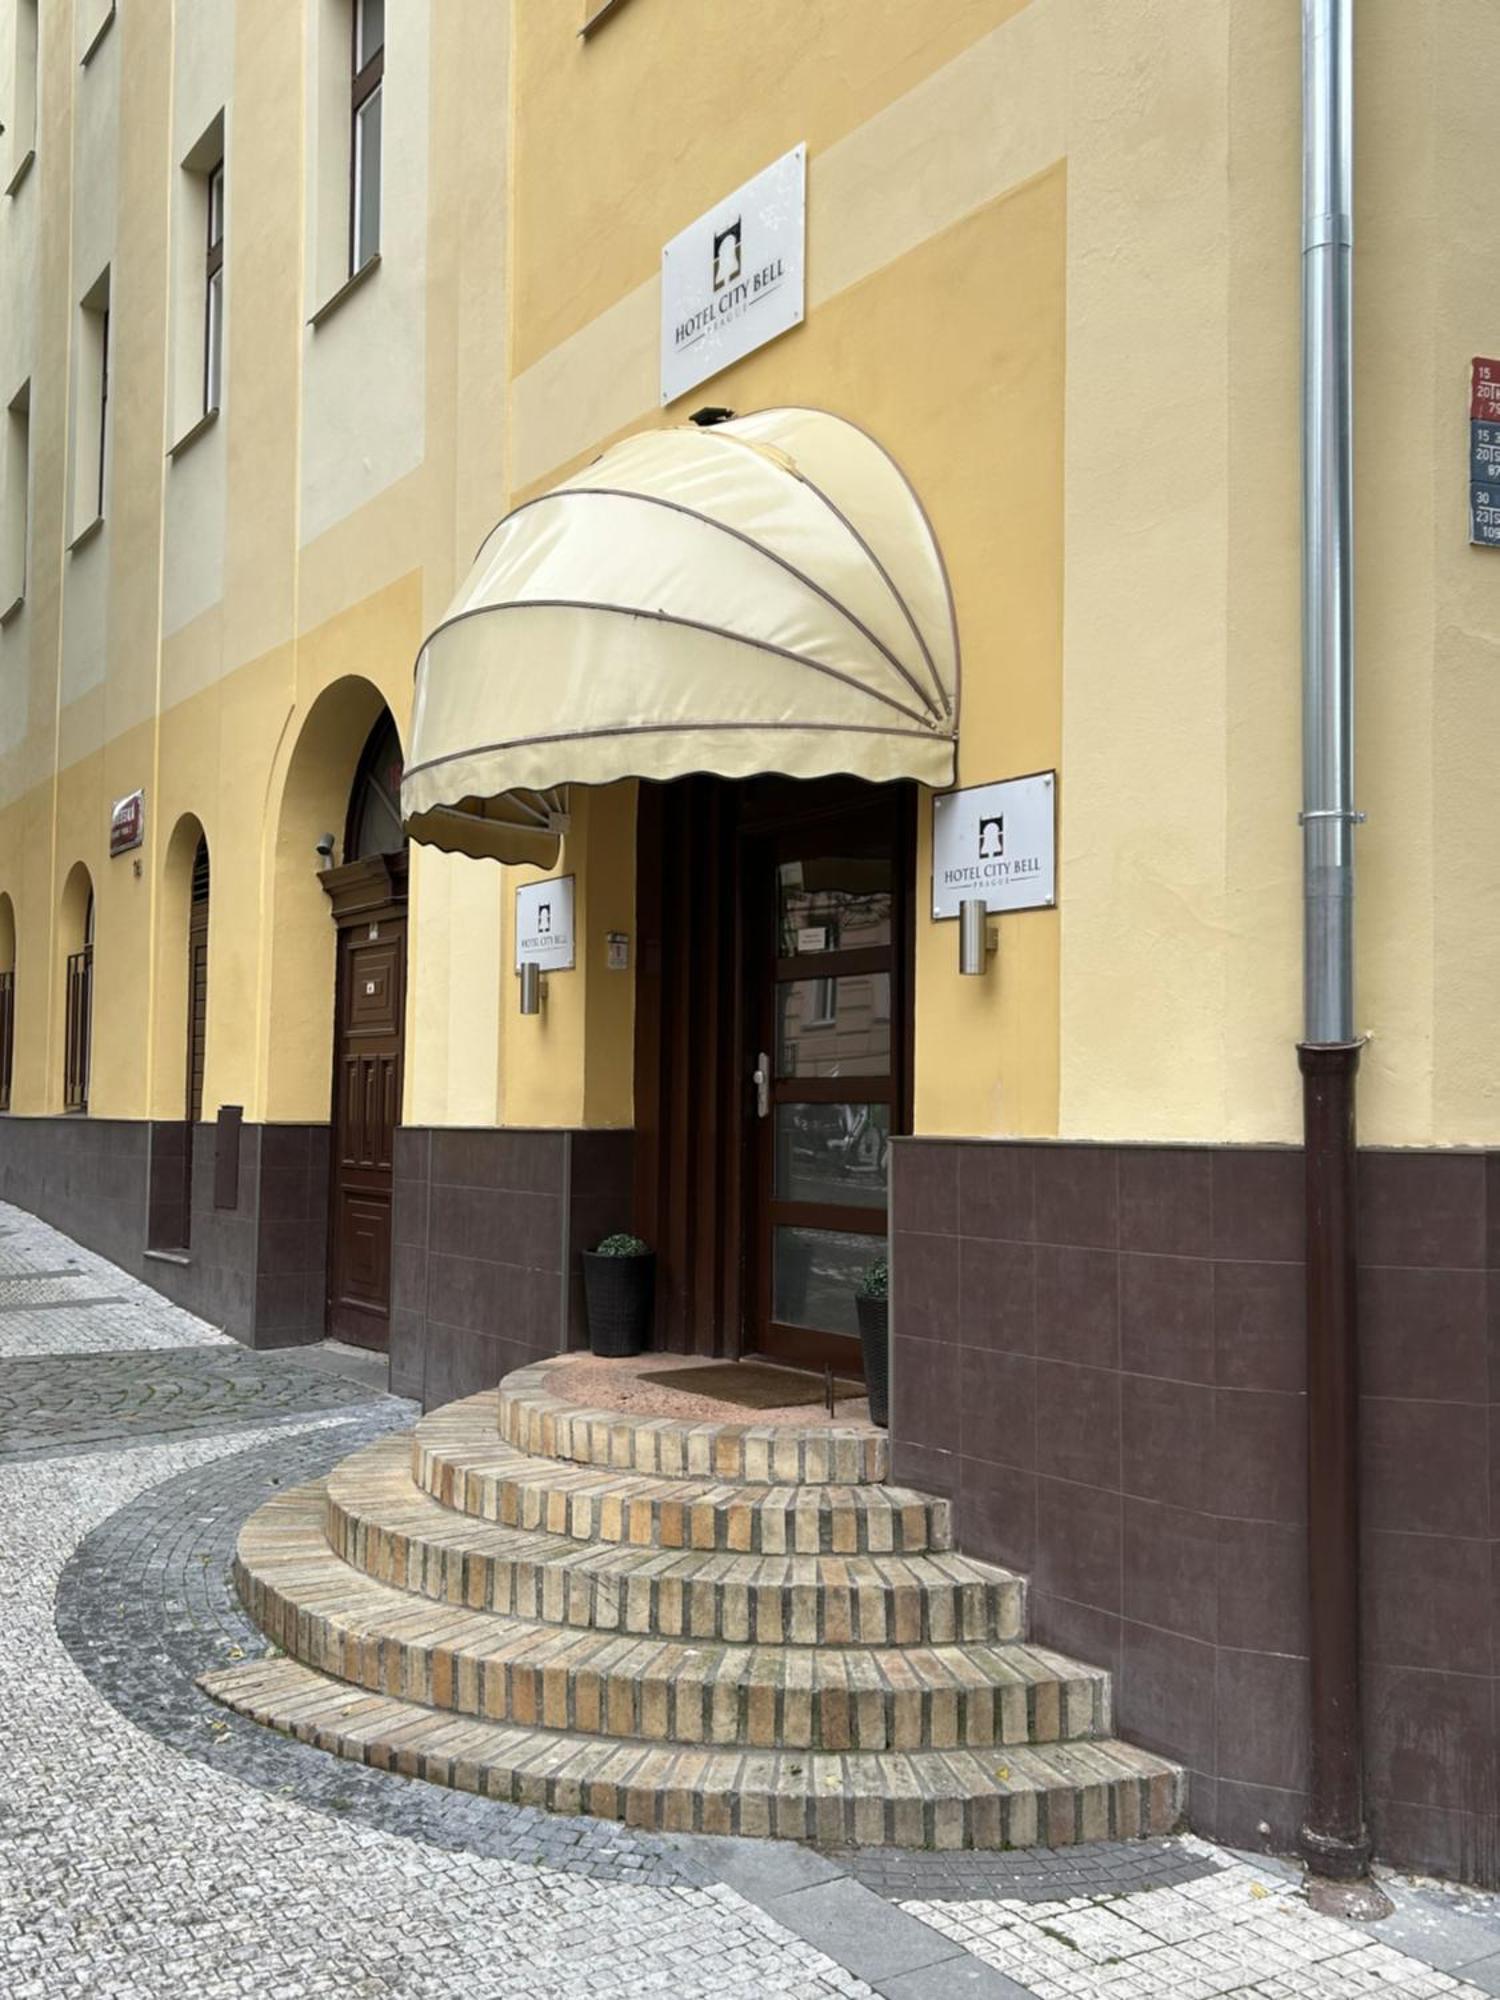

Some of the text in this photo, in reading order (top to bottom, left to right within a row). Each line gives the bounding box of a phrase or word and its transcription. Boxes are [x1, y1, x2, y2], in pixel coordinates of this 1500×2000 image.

[675, 259, 784, 344] HOTEL CITY BELL
[707, 302, 747, 332] PRAGUE
[1478, 367, 1490, 380] 15
[1477, 385, 1490, 398] 20
[1477, 430, 1490, 442] 15
[1476, 448, 1490, 460] 20
[1476, 491, 1490, 504] 30
[1476, 511, 1490, 523] 23
[944, 857, 1041, 883] HOTEL CITY BELL
[973, 878, 1010, 888] PRAGUE
